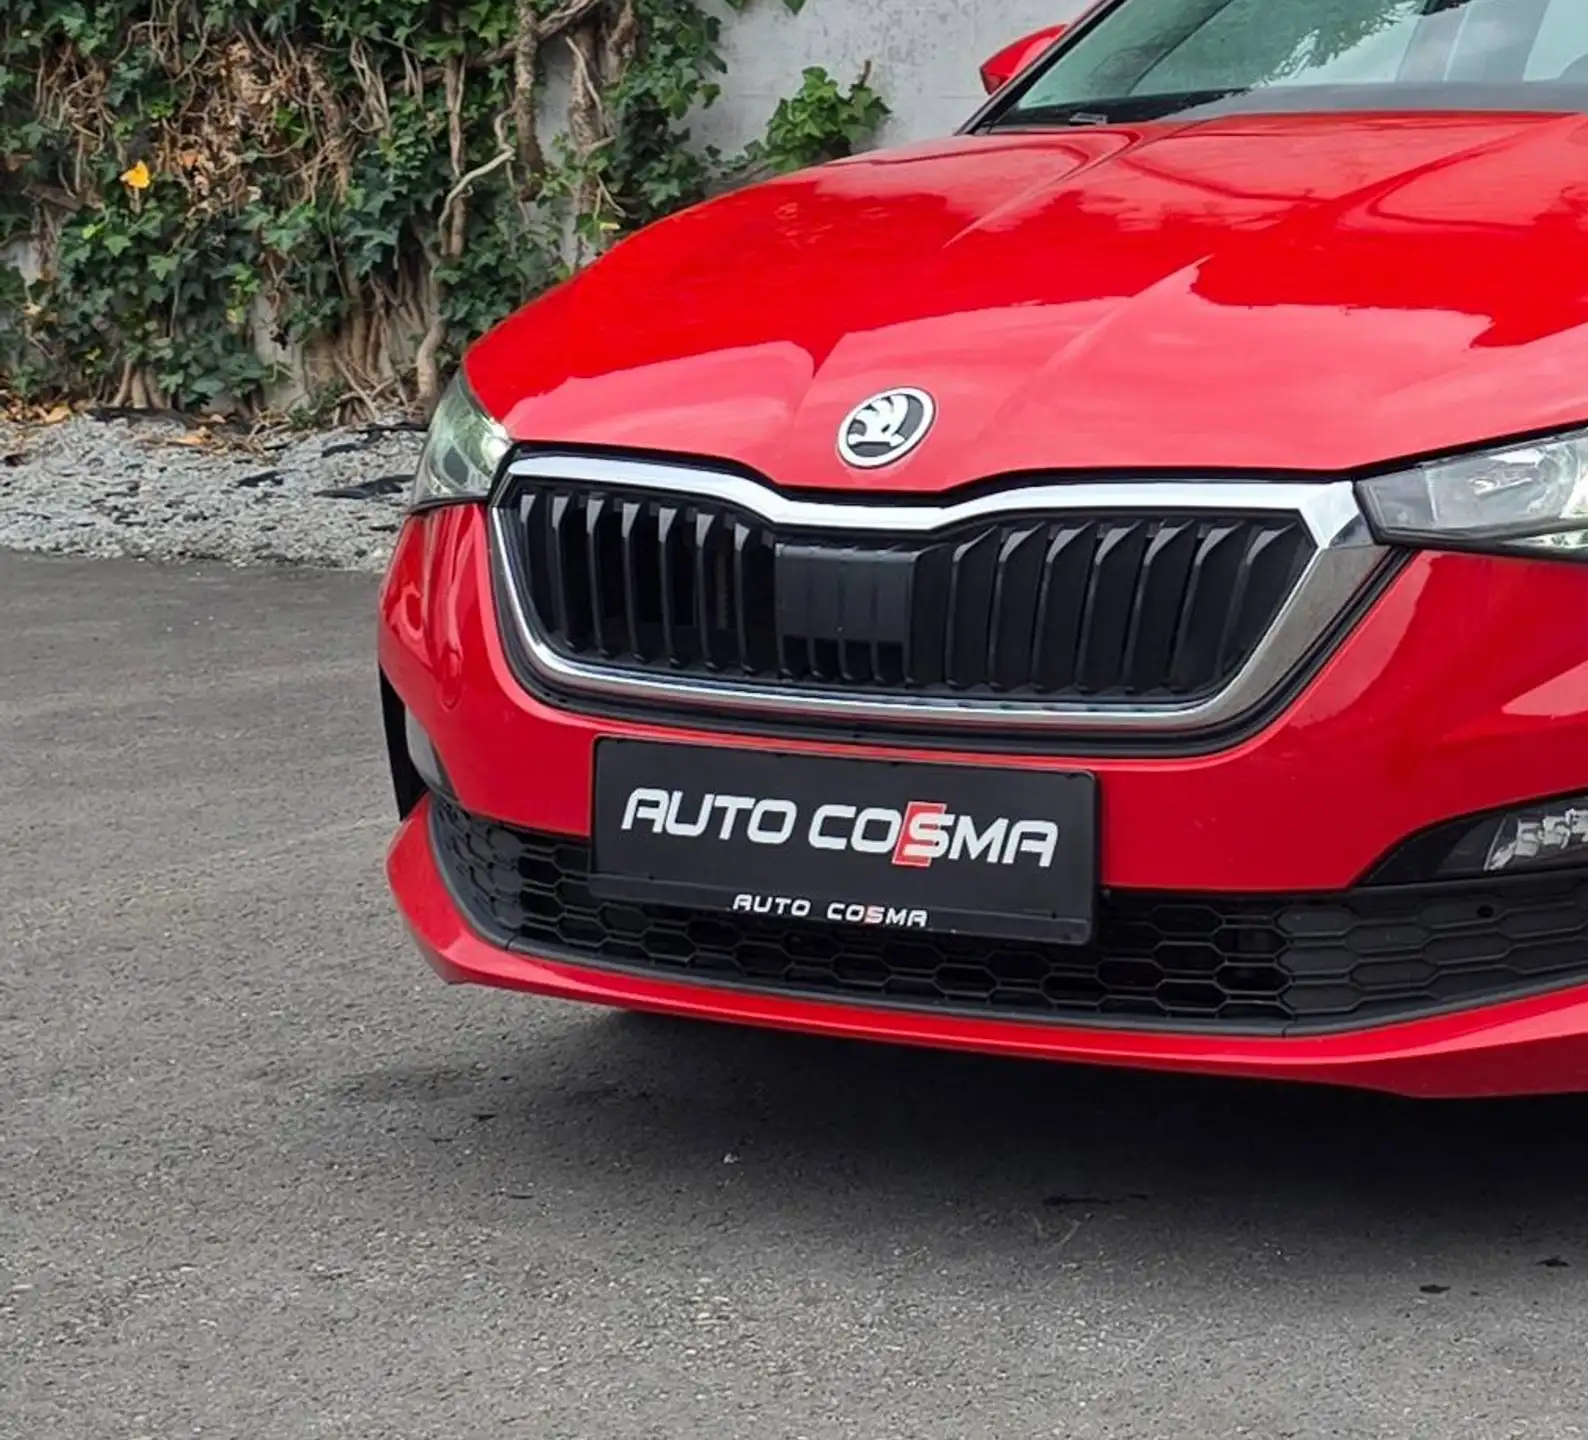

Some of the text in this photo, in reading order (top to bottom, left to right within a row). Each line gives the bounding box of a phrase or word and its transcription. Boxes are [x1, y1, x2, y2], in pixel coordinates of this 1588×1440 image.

[621, 788, 1059, 867] AUTO COSMA
[732, 894, 928, 928] AUTO COSMA
